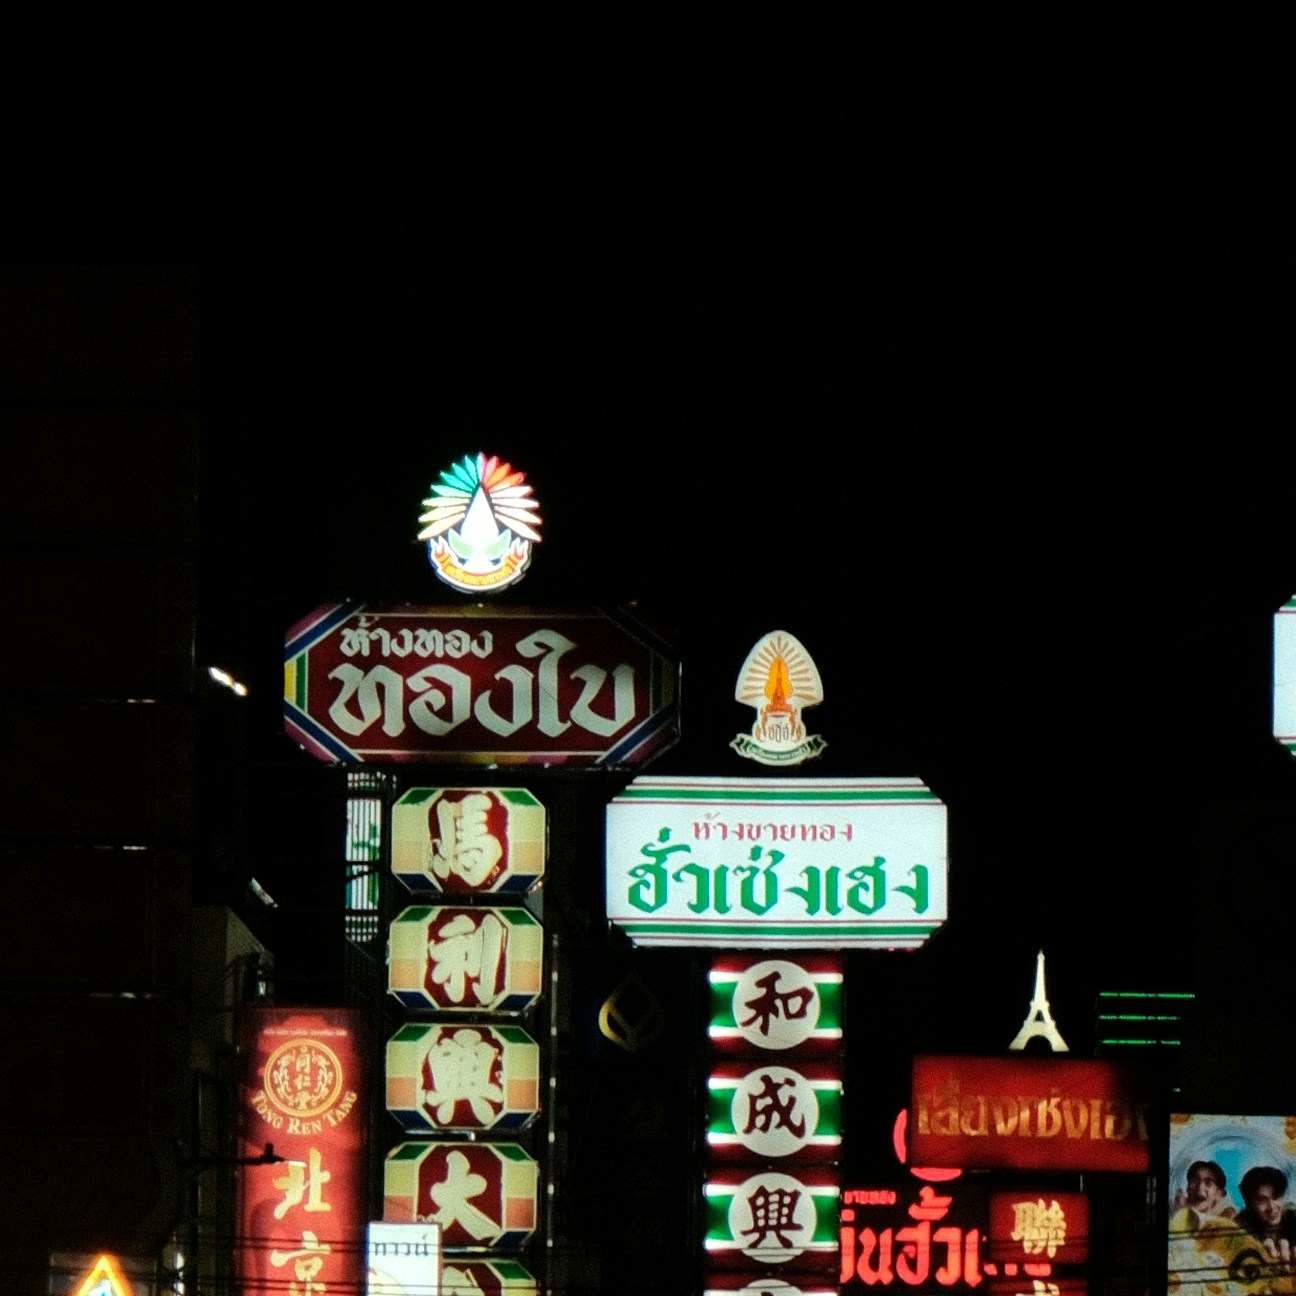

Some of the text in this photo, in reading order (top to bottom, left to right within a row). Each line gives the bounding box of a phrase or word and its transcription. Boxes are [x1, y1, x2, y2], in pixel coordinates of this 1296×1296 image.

[339, 615, 493, 659] ห้างทอง
[328, 628, 636, 738] ทองใบ
[692, 811, 853, 842] ห้างขายทอง
[627, 826, 930, 917] ฮั่วเซ่งเฮง
